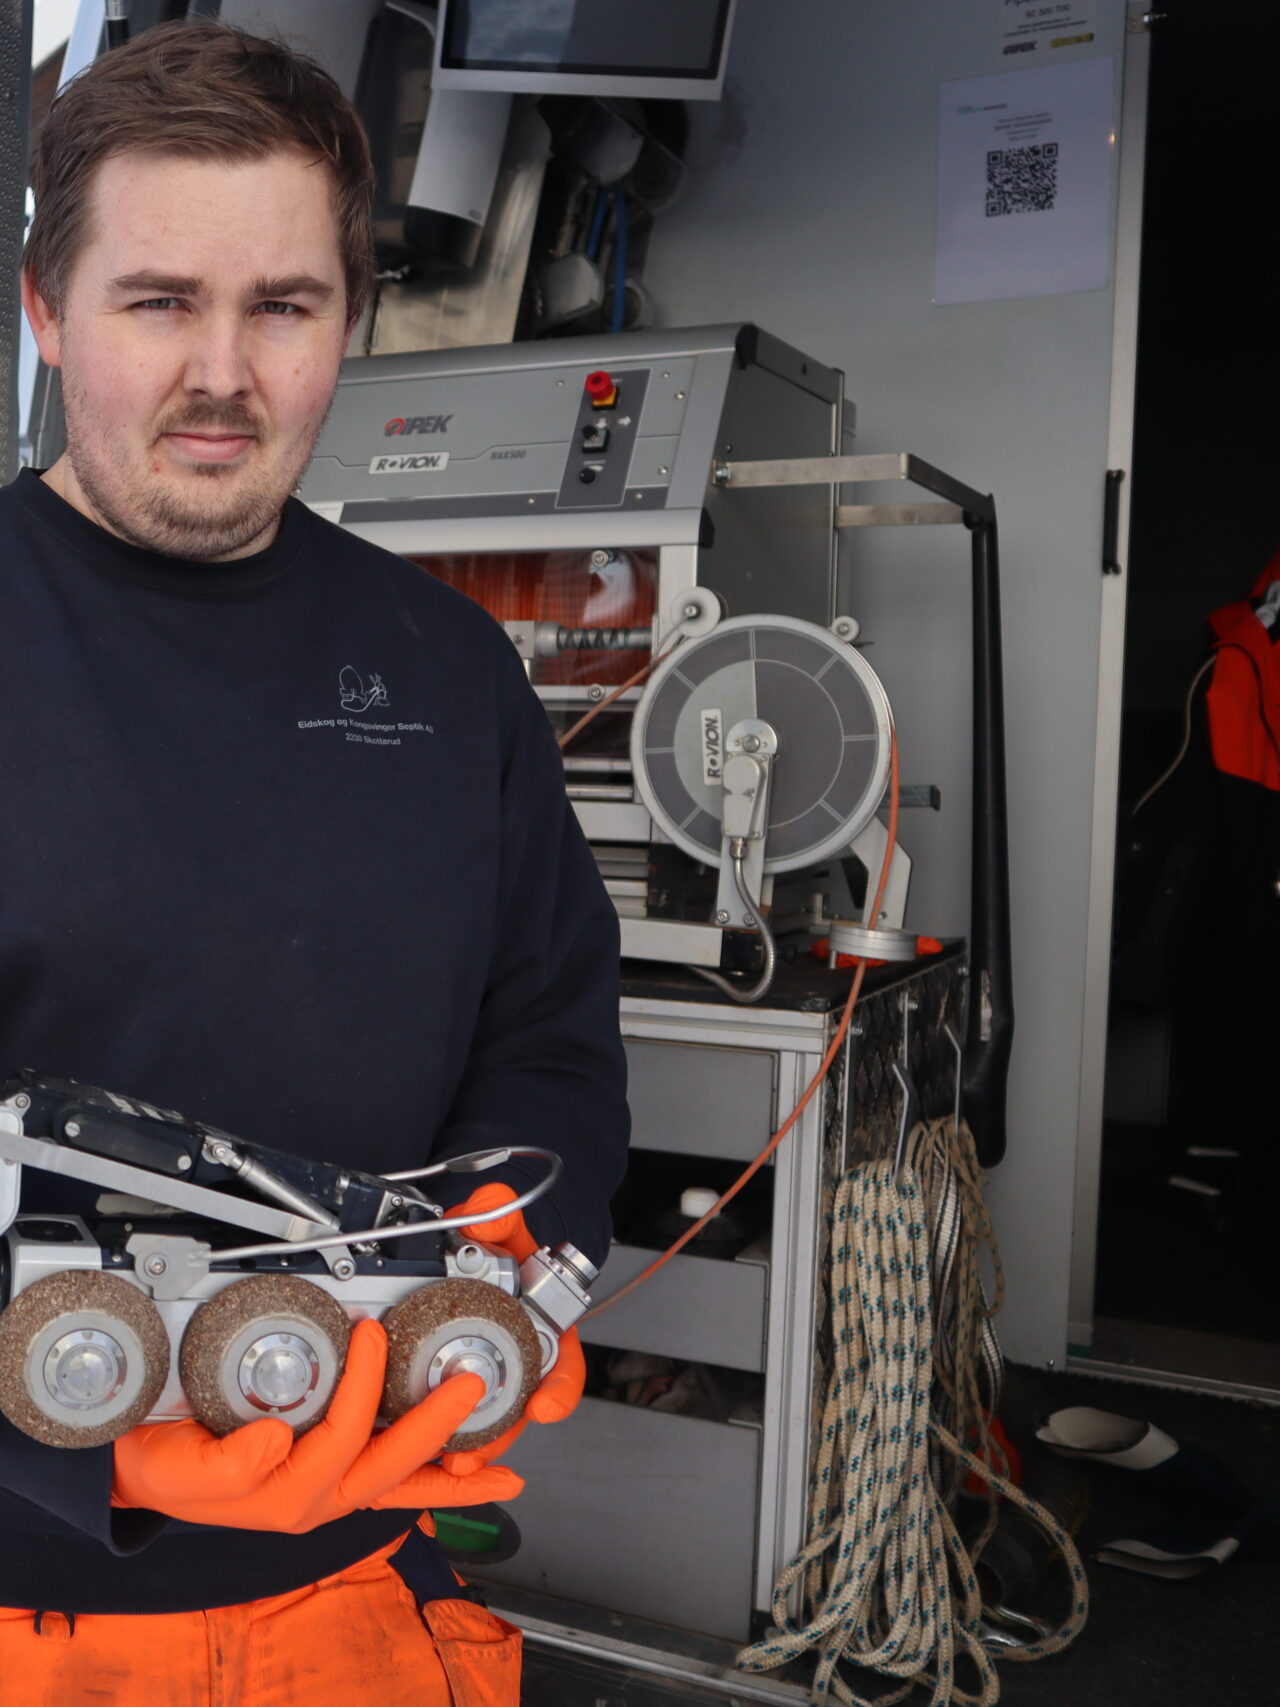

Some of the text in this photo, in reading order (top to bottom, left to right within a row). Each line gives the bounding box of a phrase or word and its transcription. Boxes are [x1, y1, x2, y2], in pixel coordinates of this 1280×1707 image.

[298, 718, 335, 729] Eidskog
[337, 718, 348, 727] og
[397, 722, 424, 731] Septik
